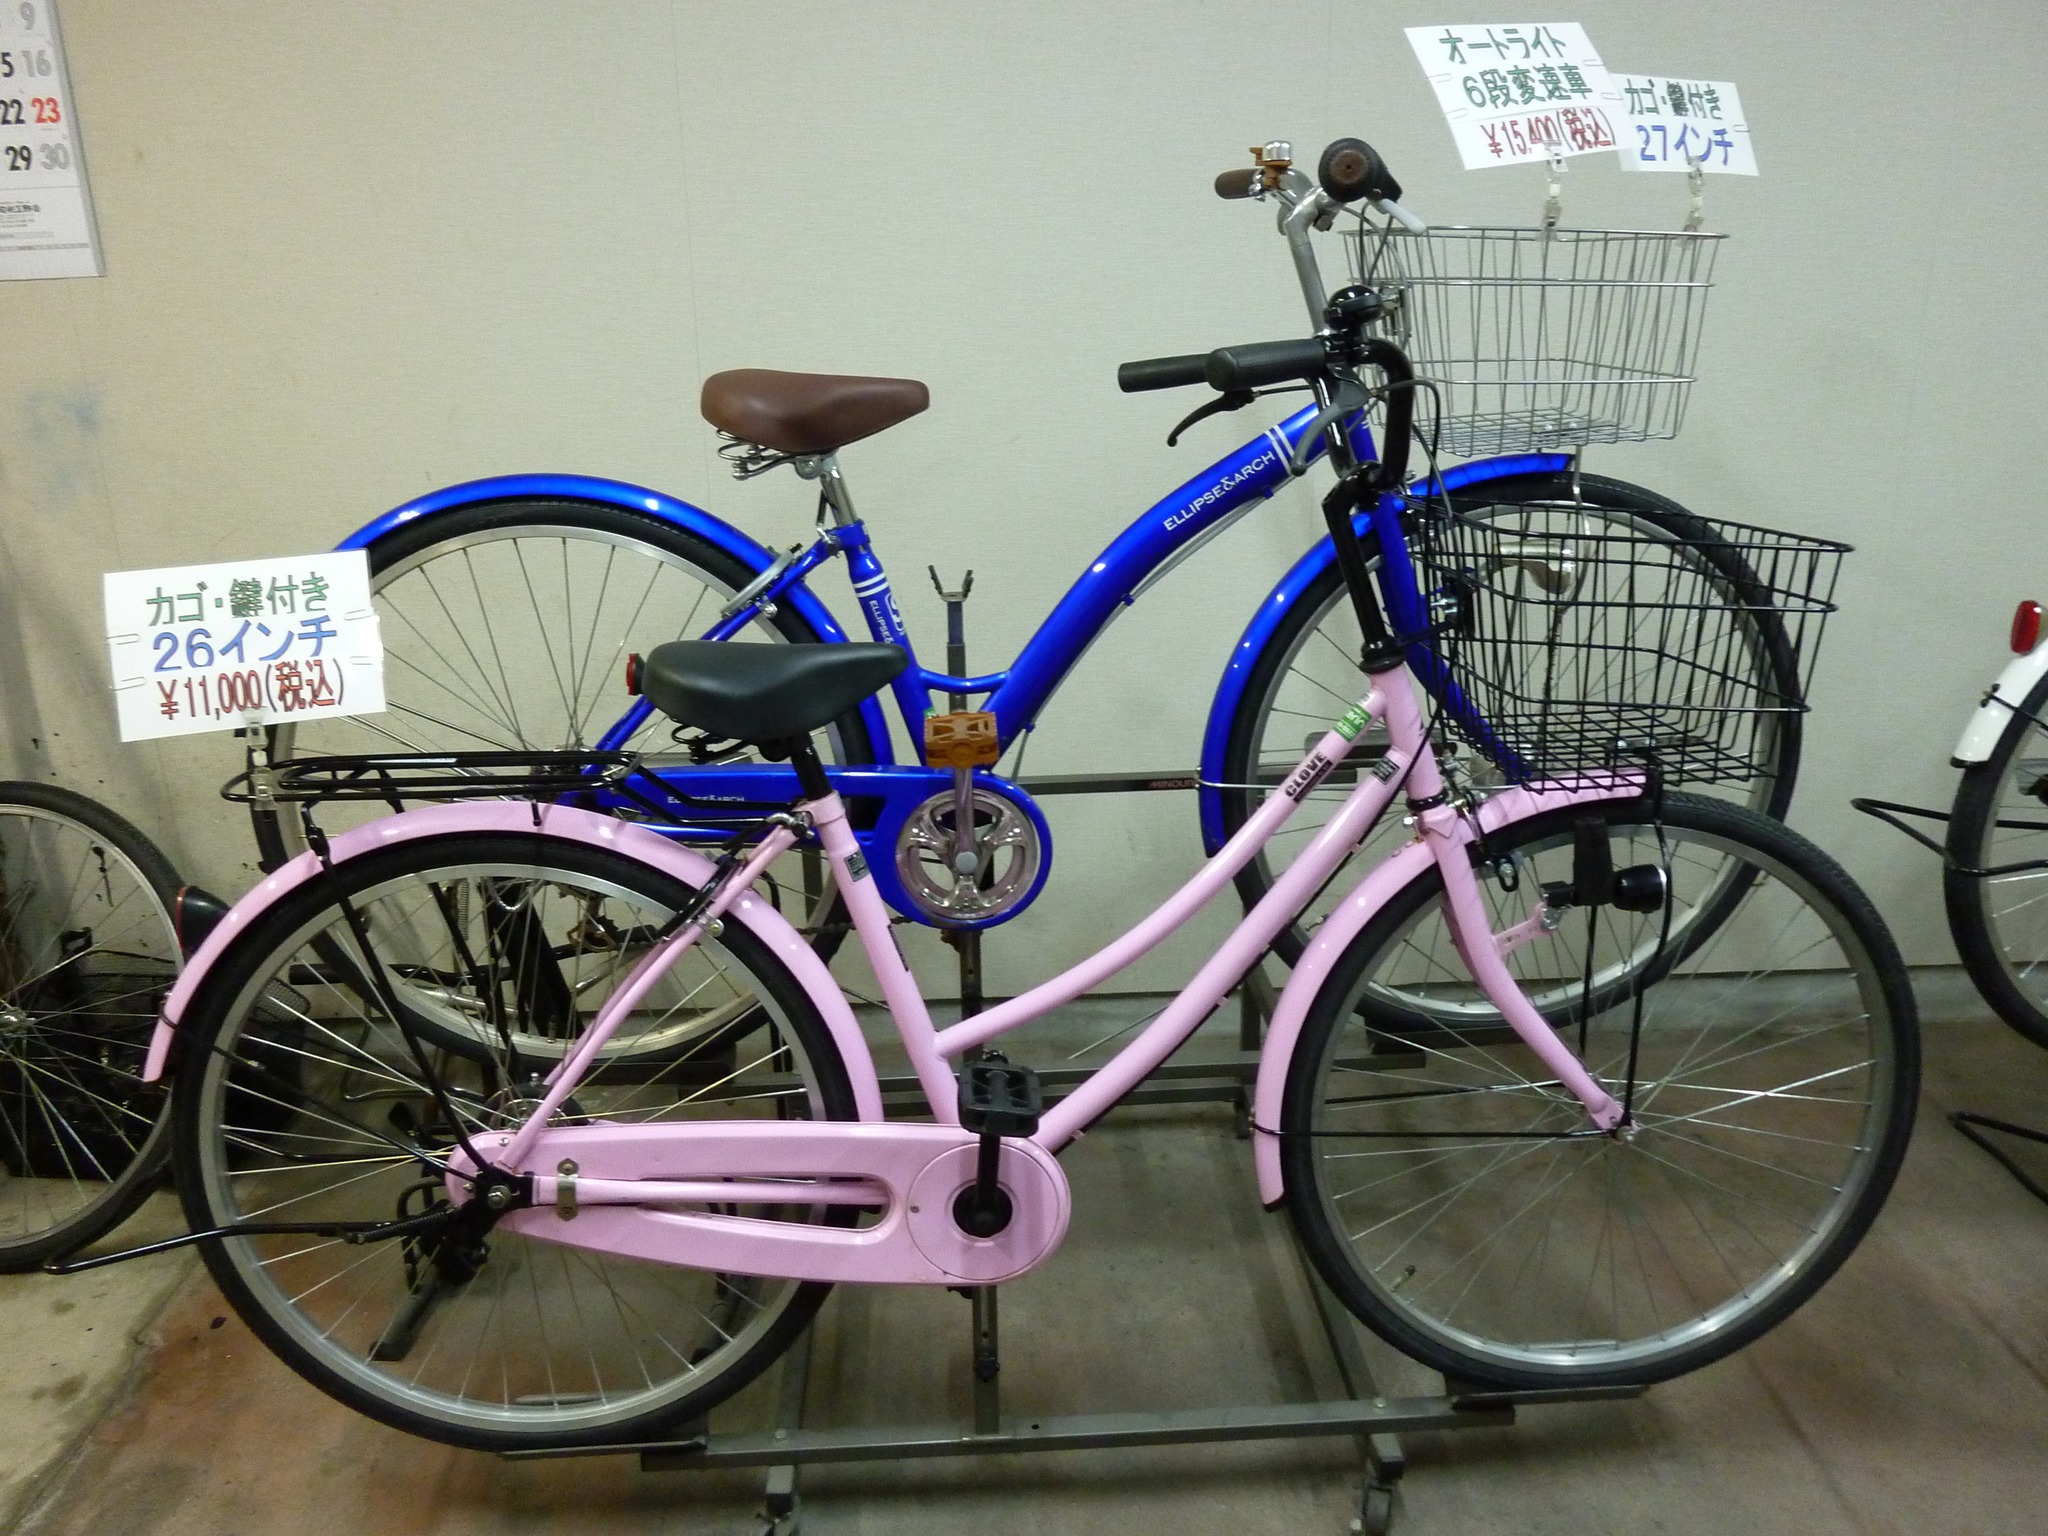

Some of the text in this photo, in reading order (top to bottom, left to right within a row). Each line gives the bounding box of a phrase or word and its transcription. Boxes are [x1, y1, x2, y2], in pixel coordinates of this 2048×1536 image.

[19, 1, 37, 31] 9
[0, 49, 52, 78] 5 16
[1438, 25, 1567, 65] オートライト
[1461, 63, 1593, 109] 6段変速車
[0, 96, 62, 126] 22 23
[5, 142, 71, 172] 29 30
[1635, 122, 1734, 166] 27インチ
[1162, 450, 1276, 532] ELLIPSE&ARCH
[868, 599, 895, 644] ELLIPSE&
[153, 614, 337, 673] 26インチ
